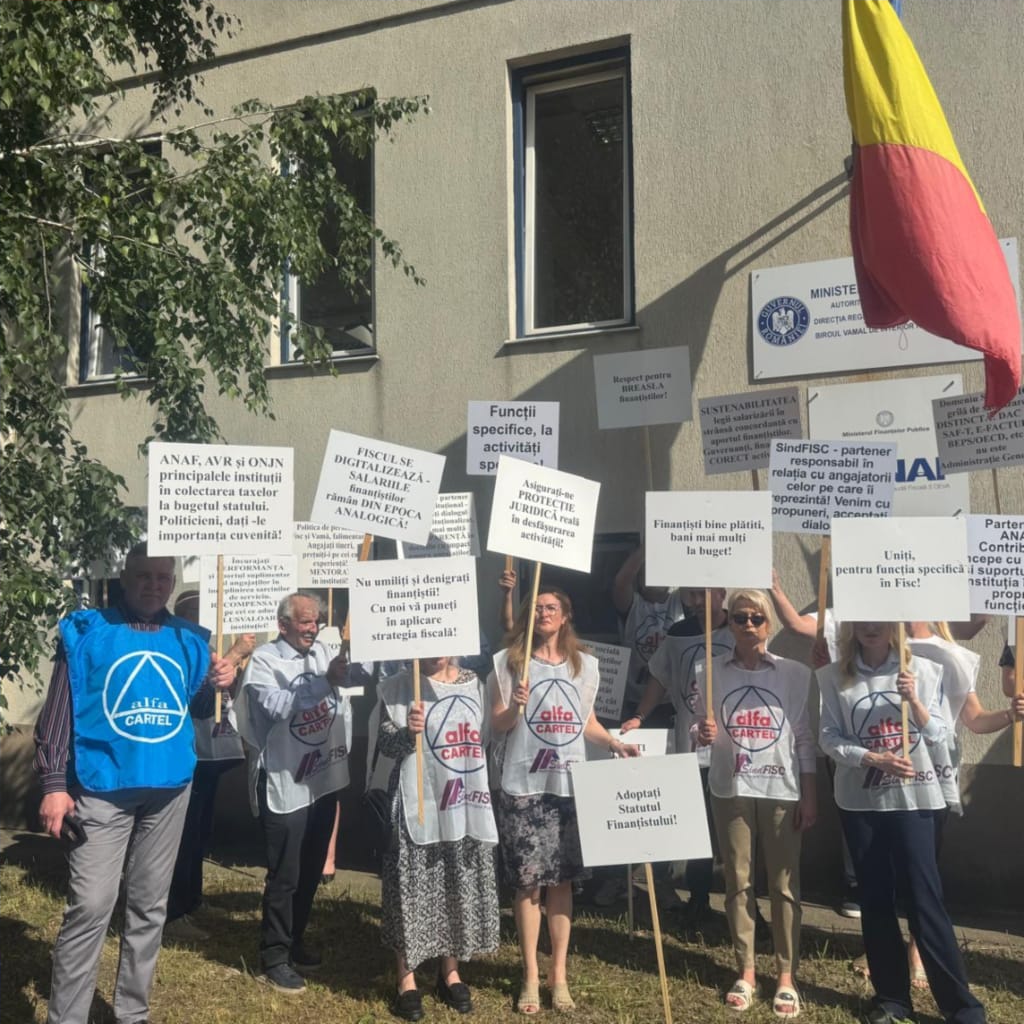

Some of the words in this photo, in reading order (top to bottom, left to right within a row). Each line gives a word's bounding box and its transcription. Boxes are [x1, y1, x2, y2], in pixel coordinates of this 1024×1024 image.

[810, 284, 857, 299] MINISTE
[160, 454, 201, 466] ANAF,
[206, 456, 232, 466] AVR
[248, 458, 283, 468] ONJN
[160, 470, 230, 484] principalele
[175, 486, 234, 496] colectarea
[239, 488, 278, 496] taxelor
[160, 500, 169, 510] la
[174, 500, 218, 513] bugetul
[223, 502, 268, 511] statului.
[160, 516, 222, 526] Politicieni,
[705, 520, 727, 528] bine
[671, 533, 692, 541] bani
[696, 534, 714, 542] mai
[687, 546, 696, 554] la
[700, 546, 731, 557] buget!
[836, 566, 872, 576] pentru
[895, 578, 920, 587] Fisc!
[131, 697, 168, 709] alfa
[125, 713, 173, 726] CARTEL
[540, 706, 573, 722] alfa
[536, 724, 578, 734] CARTEL
[616, 788, 660, 801] Adoptați
[619, 802, 660, 814] Statutul
[607, 814, 677, 830] Finanțistului!
